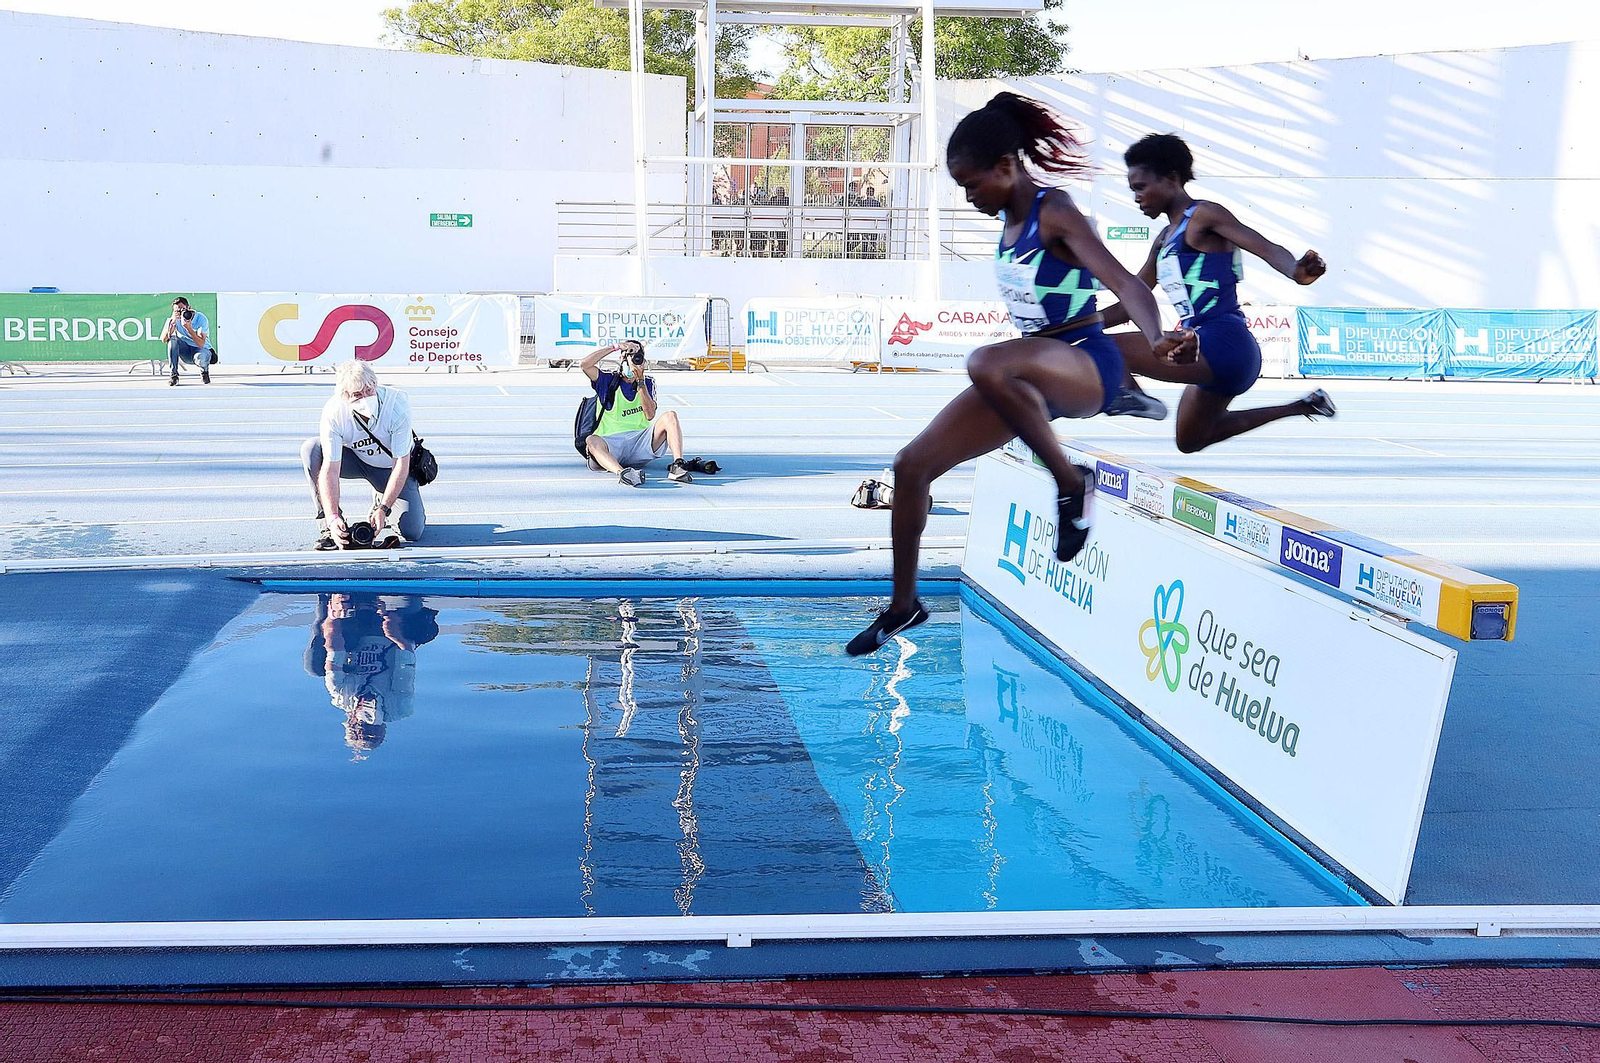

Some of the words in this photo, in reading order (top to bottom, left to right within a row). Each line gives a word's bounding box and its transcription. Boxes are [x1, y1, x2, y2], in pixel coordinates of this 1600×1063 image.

[937, 310, 1012, 325] CABAÑA
[409, 326, 458, 339] Consejo
[598, 326, 617, 338] DE
[784, 325, 803, 336] DE
[811, 325, 871, 336] HUELVA
[410, 339, 460, 351] Superior
[785, 337, 840, 346] OBJETIVOS
[1346, 341, 1366, 352] DE
[1373, 341, 1438, 353] HUELVA
[1496, 341, 1516, 353] DE
[1524, 341, 1592, 354] HUELVA
[409, 352, 425, 362] de
[428, 352, 482, 363] Deportes
[1347, 353, 1404, 362] OBJETIVOS
[621, 406, 644, 417] Joma
[1186, 503, 1213, 522] IBERDROLA
[1238, 525, 1245, 537] DE
[1246, 528, 1270, 546] HUELVA
[1033, 515, 1110, 582] DIPUCIÓN
[1028, 549, 1044, 581] DE
[1045, 558, 1093, 615] HUELVA
[1377, 569, 1423, 596] DIPUTACIÓN
[1376, 581, 1386, 594] DE
[1388, 586, 1422, 608] HUELVA
[1197, 609, 1238, 661] Que
[1239, 641, 1281, 687] sea
[1188, 656, 1214, 698] de
[1214, 671, 1301, 758] Huelva
